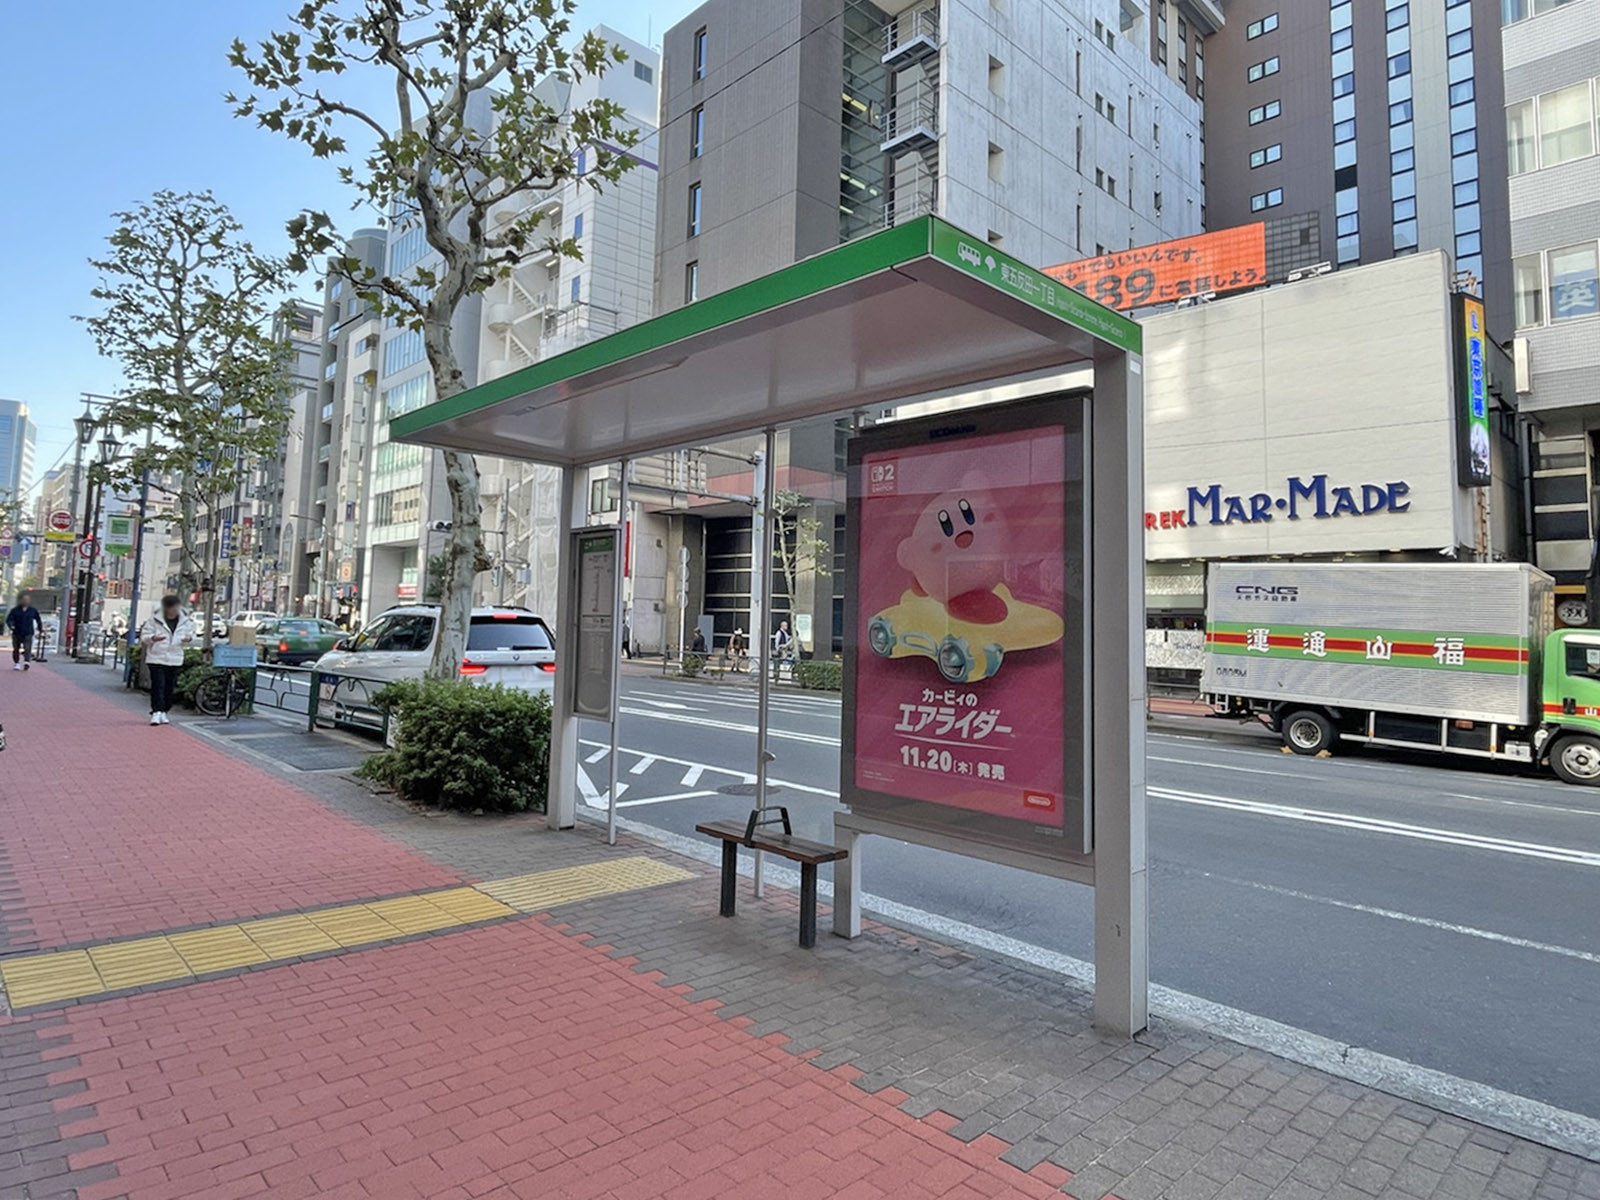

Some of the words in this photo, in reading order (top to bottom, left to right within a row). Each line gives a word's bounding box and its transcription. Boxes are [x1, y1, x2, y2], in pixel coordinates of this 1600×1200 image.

[1000, 262, 1055, 306] 東五反田一丁目
[1235, 585, 1299, 595] CNG
[922, 688, 978, 706] カービィの
[894, 703, 1012, 740] エアライダー
[977, 761, 1006, 781] 発売
